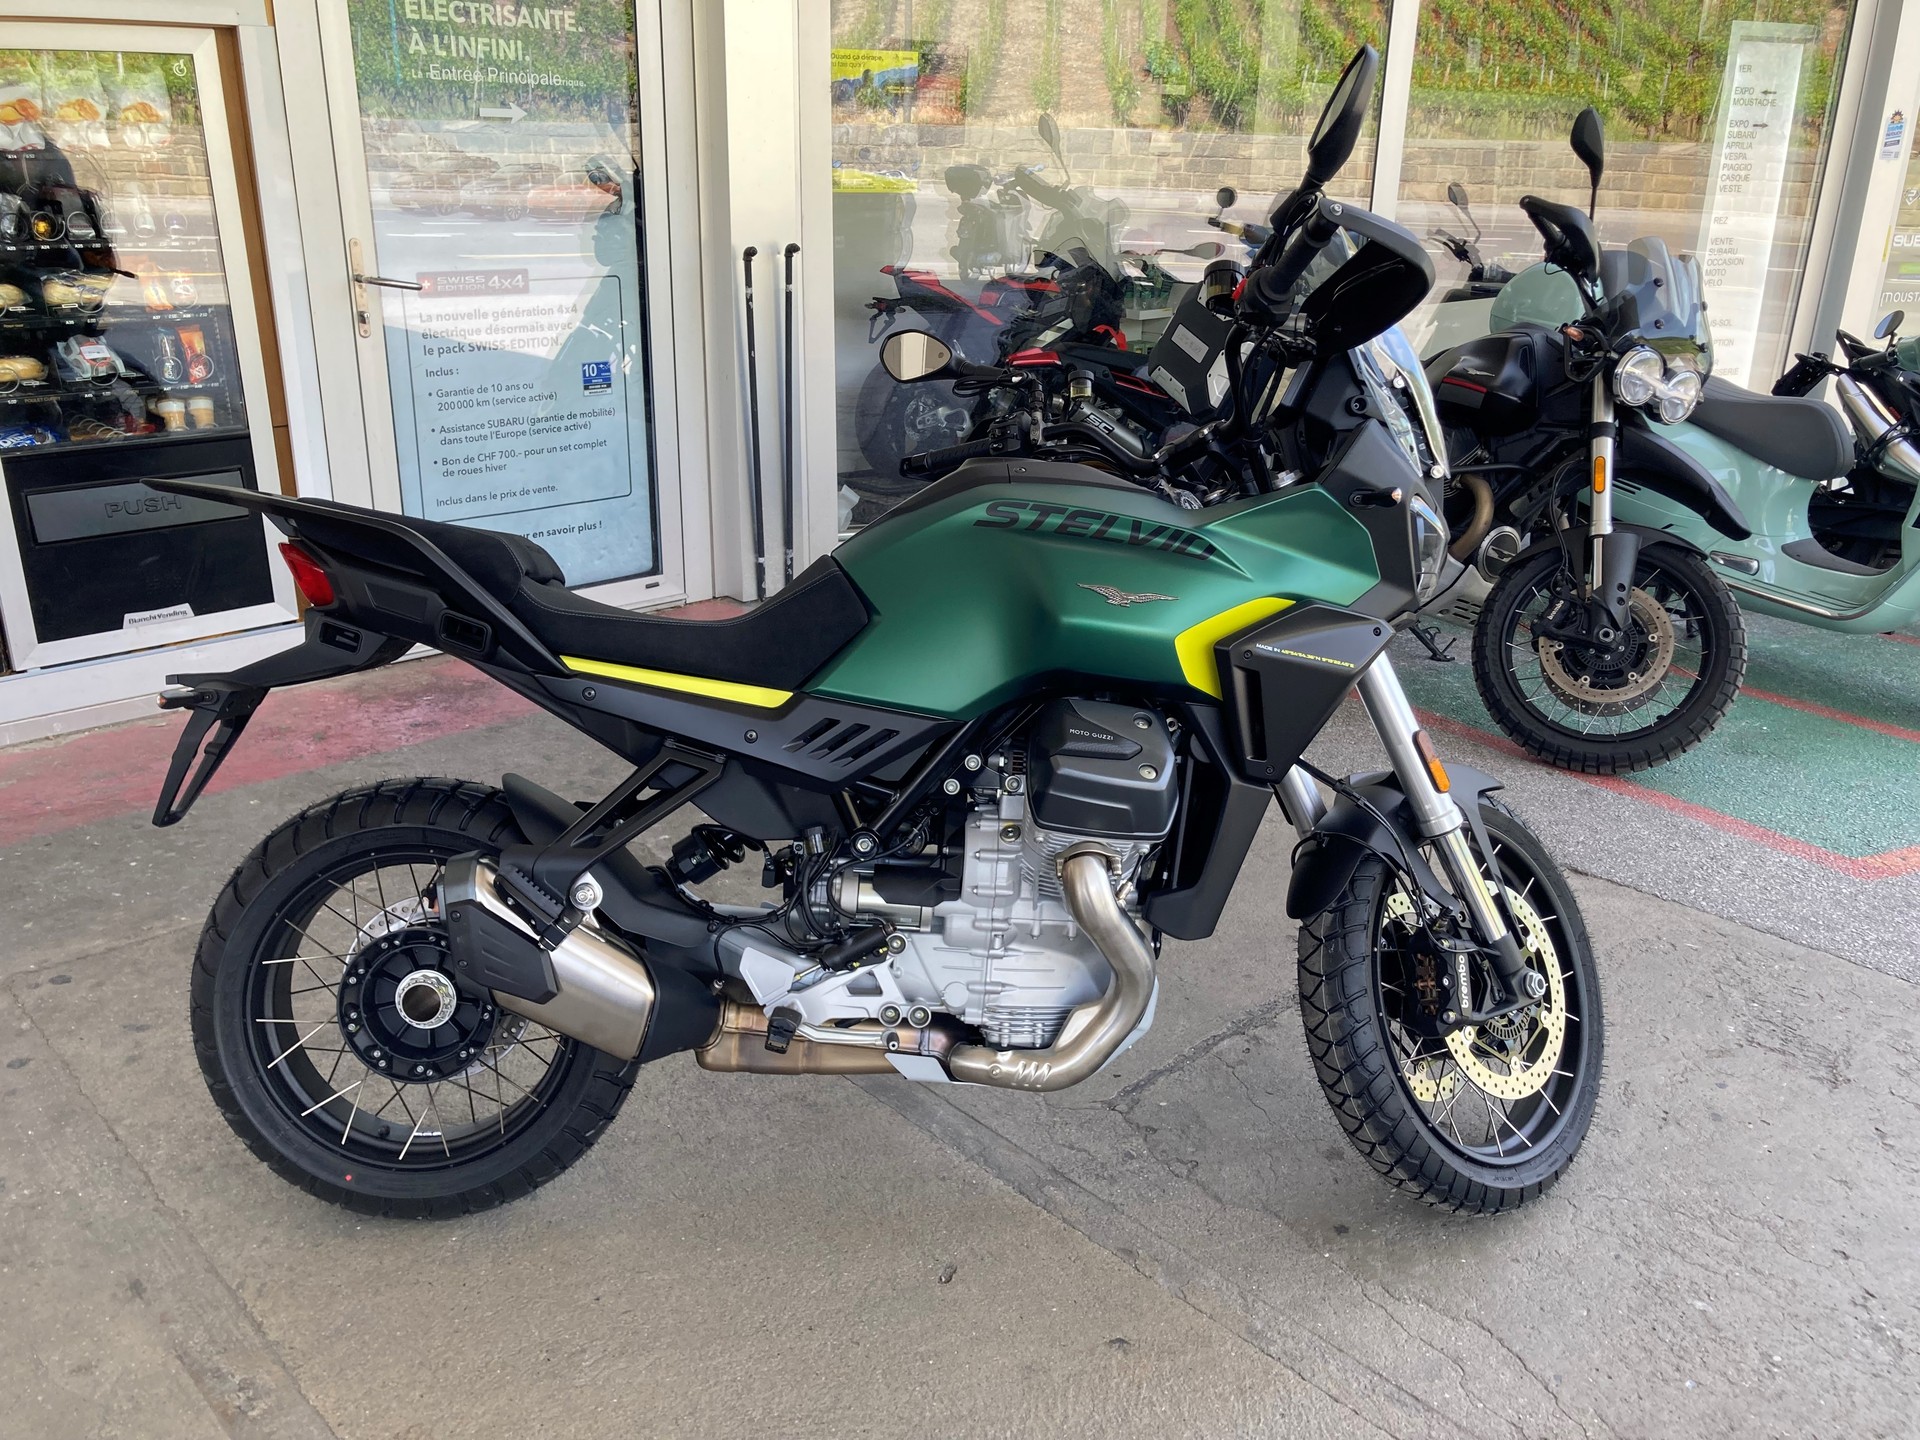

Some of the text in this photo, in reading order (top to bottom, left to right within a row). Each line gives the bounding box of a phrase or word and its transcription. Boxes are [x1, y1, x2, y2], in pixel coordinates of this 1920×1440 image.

[408, 26, 530, 61] À L'INFINI.
[429, 63, 561, 88] Entrée Principale
[1735, 86, 1755, 95] EXPO
[1732, 98, 1777, 107] MOUSTACHE
[1729, 119, 1750, 128] EXPO
[1727, 131, 1758, 139] SUBARU
[1725, 142, 1753, 150] APRILIA
[1724, 152, 1747, 161] VESPA
[1721, 163, 1753, 172] PIAGGIO
[1720, 174, 1751, 182] CASQUE
[1719, 185, 1743, 193] VESTE
[1710, 237, 1735, 246] VENTE
[1708, 247, 1739, 256] SUBARU
[1706, 258, 1745, 267] OCCASION
[437, 275, 486, 285] SWISS
[1705, 268, 1727, 277] MOTO
[437, 282, 486, 292] EDITION
[488, 274, 525, 290] 4x4
[419, 304, 578, 324] La nouvelle génération 4x4
[422, 322, 573, 342] électrique désormais avec
[423, 336, 563, 358] le pack SWISS-EDITION.
[425, 367, 454, 378] Inclus
[583, 363, 598, 378] 10
[436, 382, 534, 399] Garantie de 10 ans ou
[476, 398, 491, 408] km
[492, 395, 526, 408] (service
[528, 391, 558, 403] activé)
[439, 407, 616, 435] Assistance SUBARU (garantie de mobilité)
[440, 421, 592, 446] dans toute l'Europe (service activé)
[441, 455, 461, 466] Bon
[463, 454, 476, 465] de
[477, 452, 497, 463] CHF
[523, 447, 545, 458] pour
[546, 445, 558, 454] un
[559, 443, 572, 453] set
[573, 439, 608, 451] complet
[442, 462, 508, 478] de roues hiver
[436, 483, 558, 507] Inclus dans le prix de vente.
[104, 494, 183, 518] PUSH
[532, 530, 544, 539] en
[546, 524, 576, 537] savoir
[578, 521, 597, 534] plus
[972, 500, 1218, 561] STELVIO
[1546, 600, 1565, 620] brembo
[1069, 728, 1114, 741] MOTO GUZZI
[1458, 954, 1469, 1009] brembo
